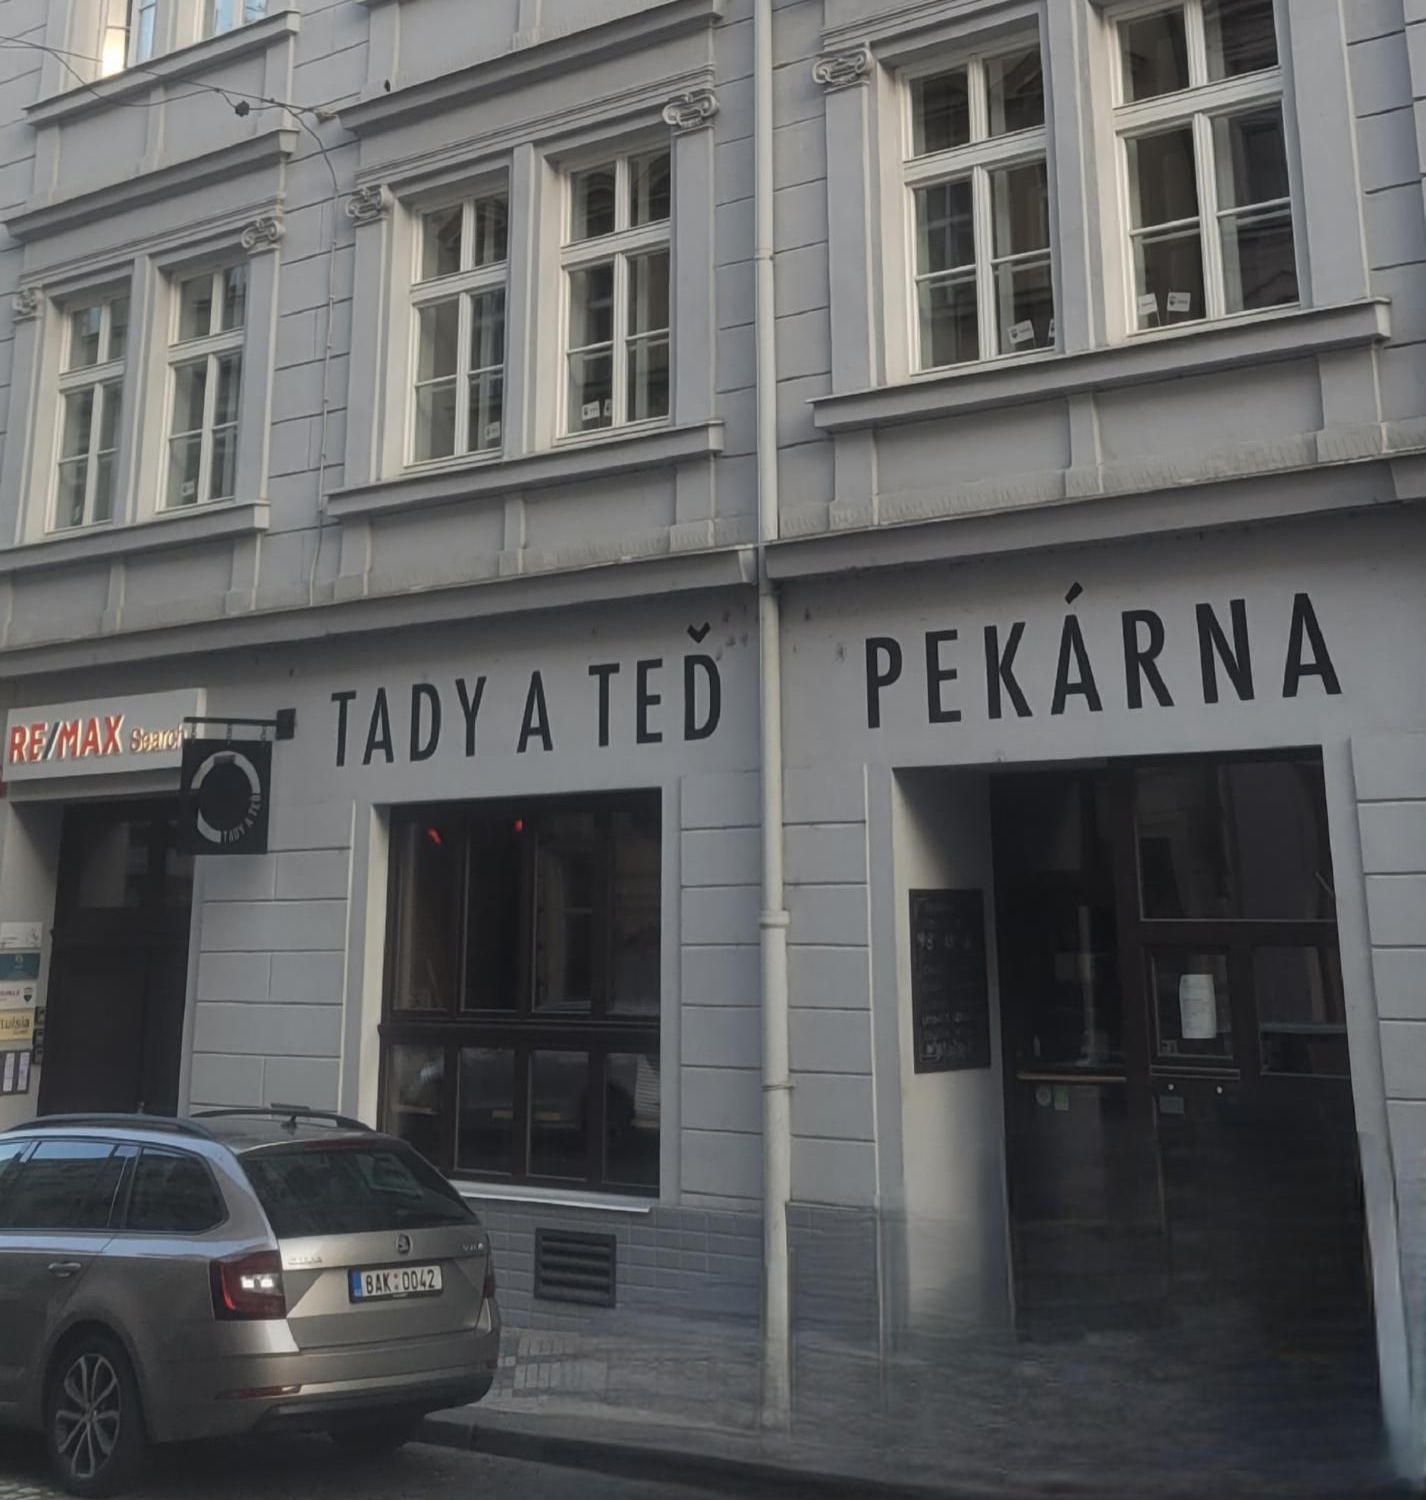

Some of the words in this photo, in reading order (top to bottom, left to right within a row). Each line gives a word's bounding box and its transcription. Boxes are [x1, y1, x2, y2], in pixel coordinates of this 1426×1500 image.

[331, 676, 487, 767] TADY
[517, 670, 553, 753] A
[588, 622, 721, 747] TEĎ
[865, 582, 1342, 728] PEKÁRNA
[10, 715, 124, 764] RE/MAX
[366, 1274, 392, 1294] 8AK
[402, 1269, 435, 1291] 0042
